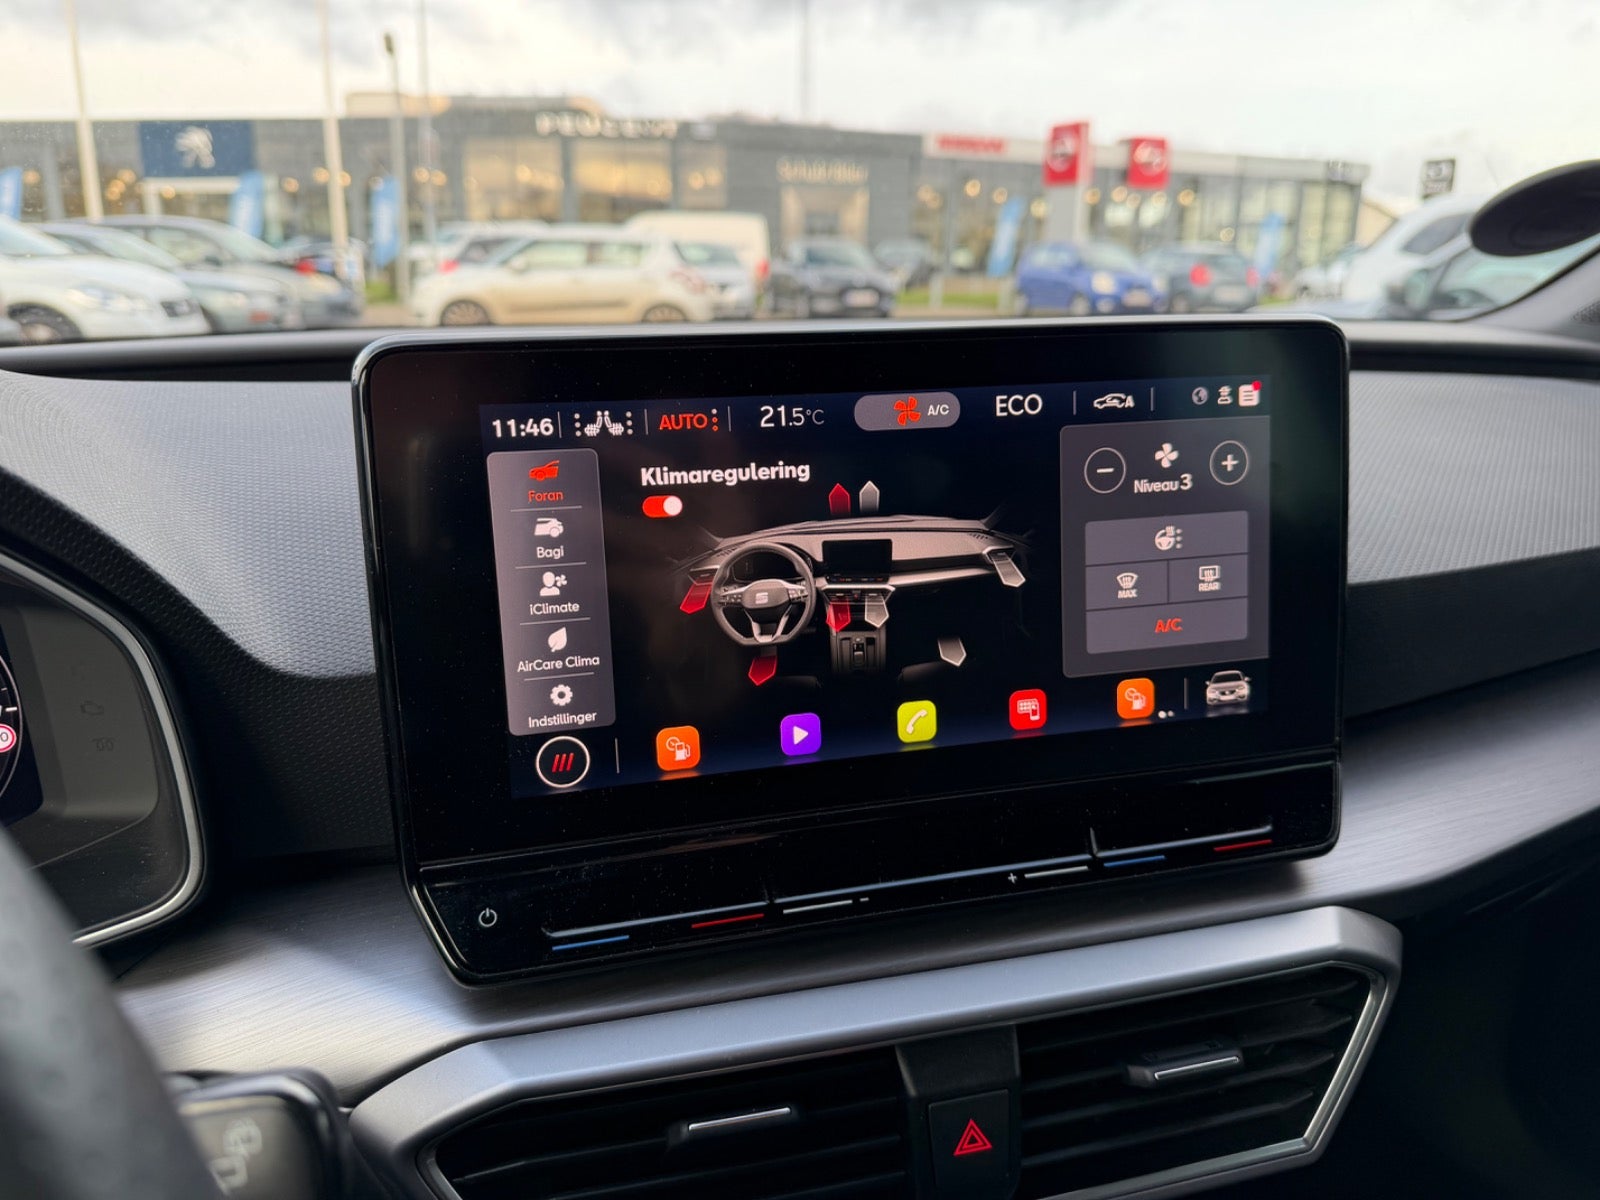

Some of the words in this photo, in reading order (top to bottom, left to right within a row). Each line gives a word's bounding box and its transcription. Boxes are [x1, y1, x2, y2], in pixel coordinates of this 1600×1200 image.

[927, 403, 950, 417] A/C
[995, 393, 1043, 417] ECO
[492, 418, 554, 438] 11:46
[659, 413, 708, 431] AUTO
[640, 460, 811, 487] Klimaregulering
[1133, 478, 1179, 494] Niveau
[1180, 473, 1193, 491] 3
[528, 489, 564, 503] Foran
[536, 545, 564, 560] Bagi
[1117, 588, 1138, 599] MAX
[1198, 581, 1221, 592] REAR
[529, 601, 580, 616] iClimate
[1155, 618, 1182, 633] A/C
[517, 658, 563, 673] AirCare
[565, 655, 600, 668] Clima
[528, 711, 597, 729] Indstillinger
